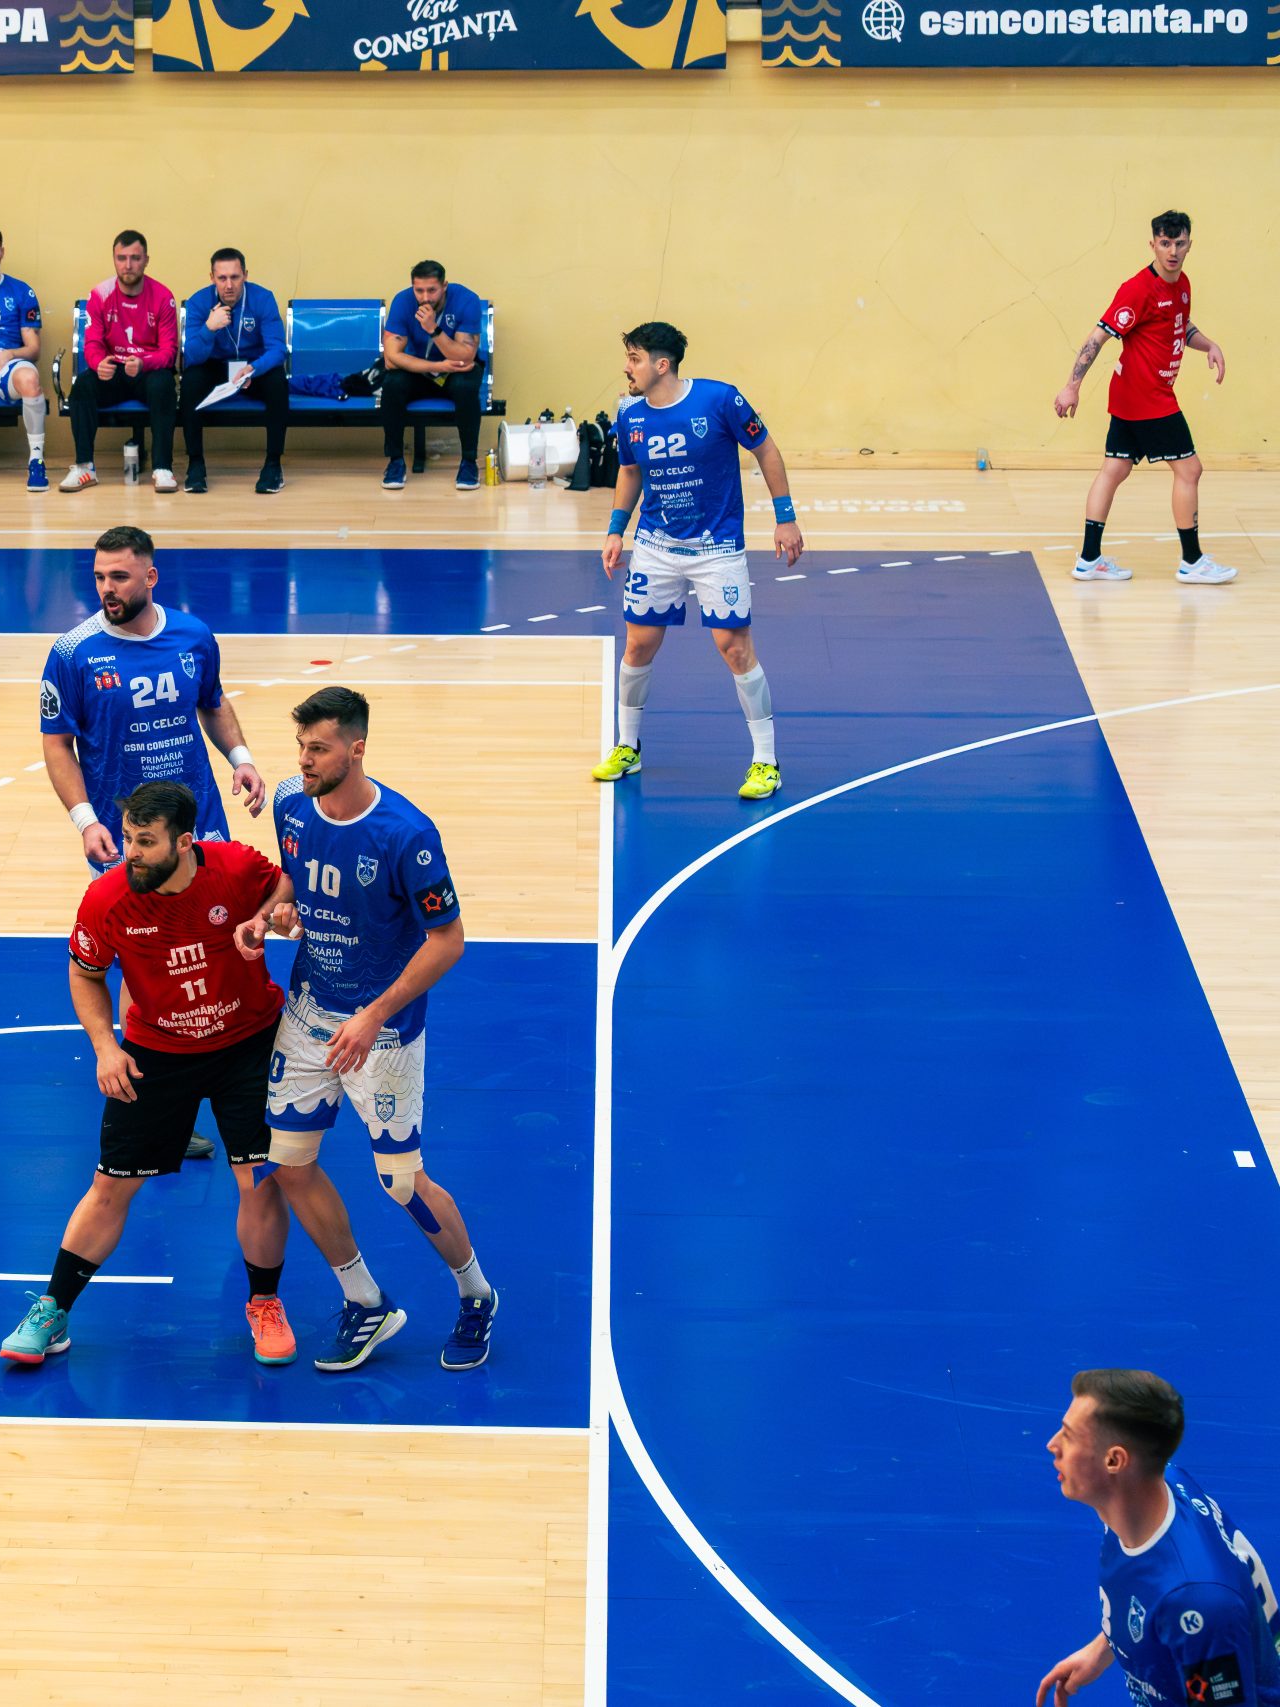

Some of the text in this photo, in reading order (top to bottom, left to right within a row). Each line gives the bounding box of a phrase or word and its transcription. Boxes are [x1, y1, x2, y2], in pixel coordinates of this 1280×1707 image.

[919, 3, 1249, 36] csmconstanta.ro
[353, 9, 518, 61] CONSTANȚA
[124, 326, 134, 345] 1
[647, 433, 687, 460] 22
[87, 655, 116, 664] Kempa
[129, 671, 180, 709] 24
[124, 743, 145, 752] CSM
[304, 858, 341, 898] 10
[126, 925, 159, 936] Kempa
[166, 942, 206, 968] JTTI
[168, 961, 208, 976] ROMANIA
[181, 978, 207, 1001] 11
[108, 1168, 131, 1176] Kempa
